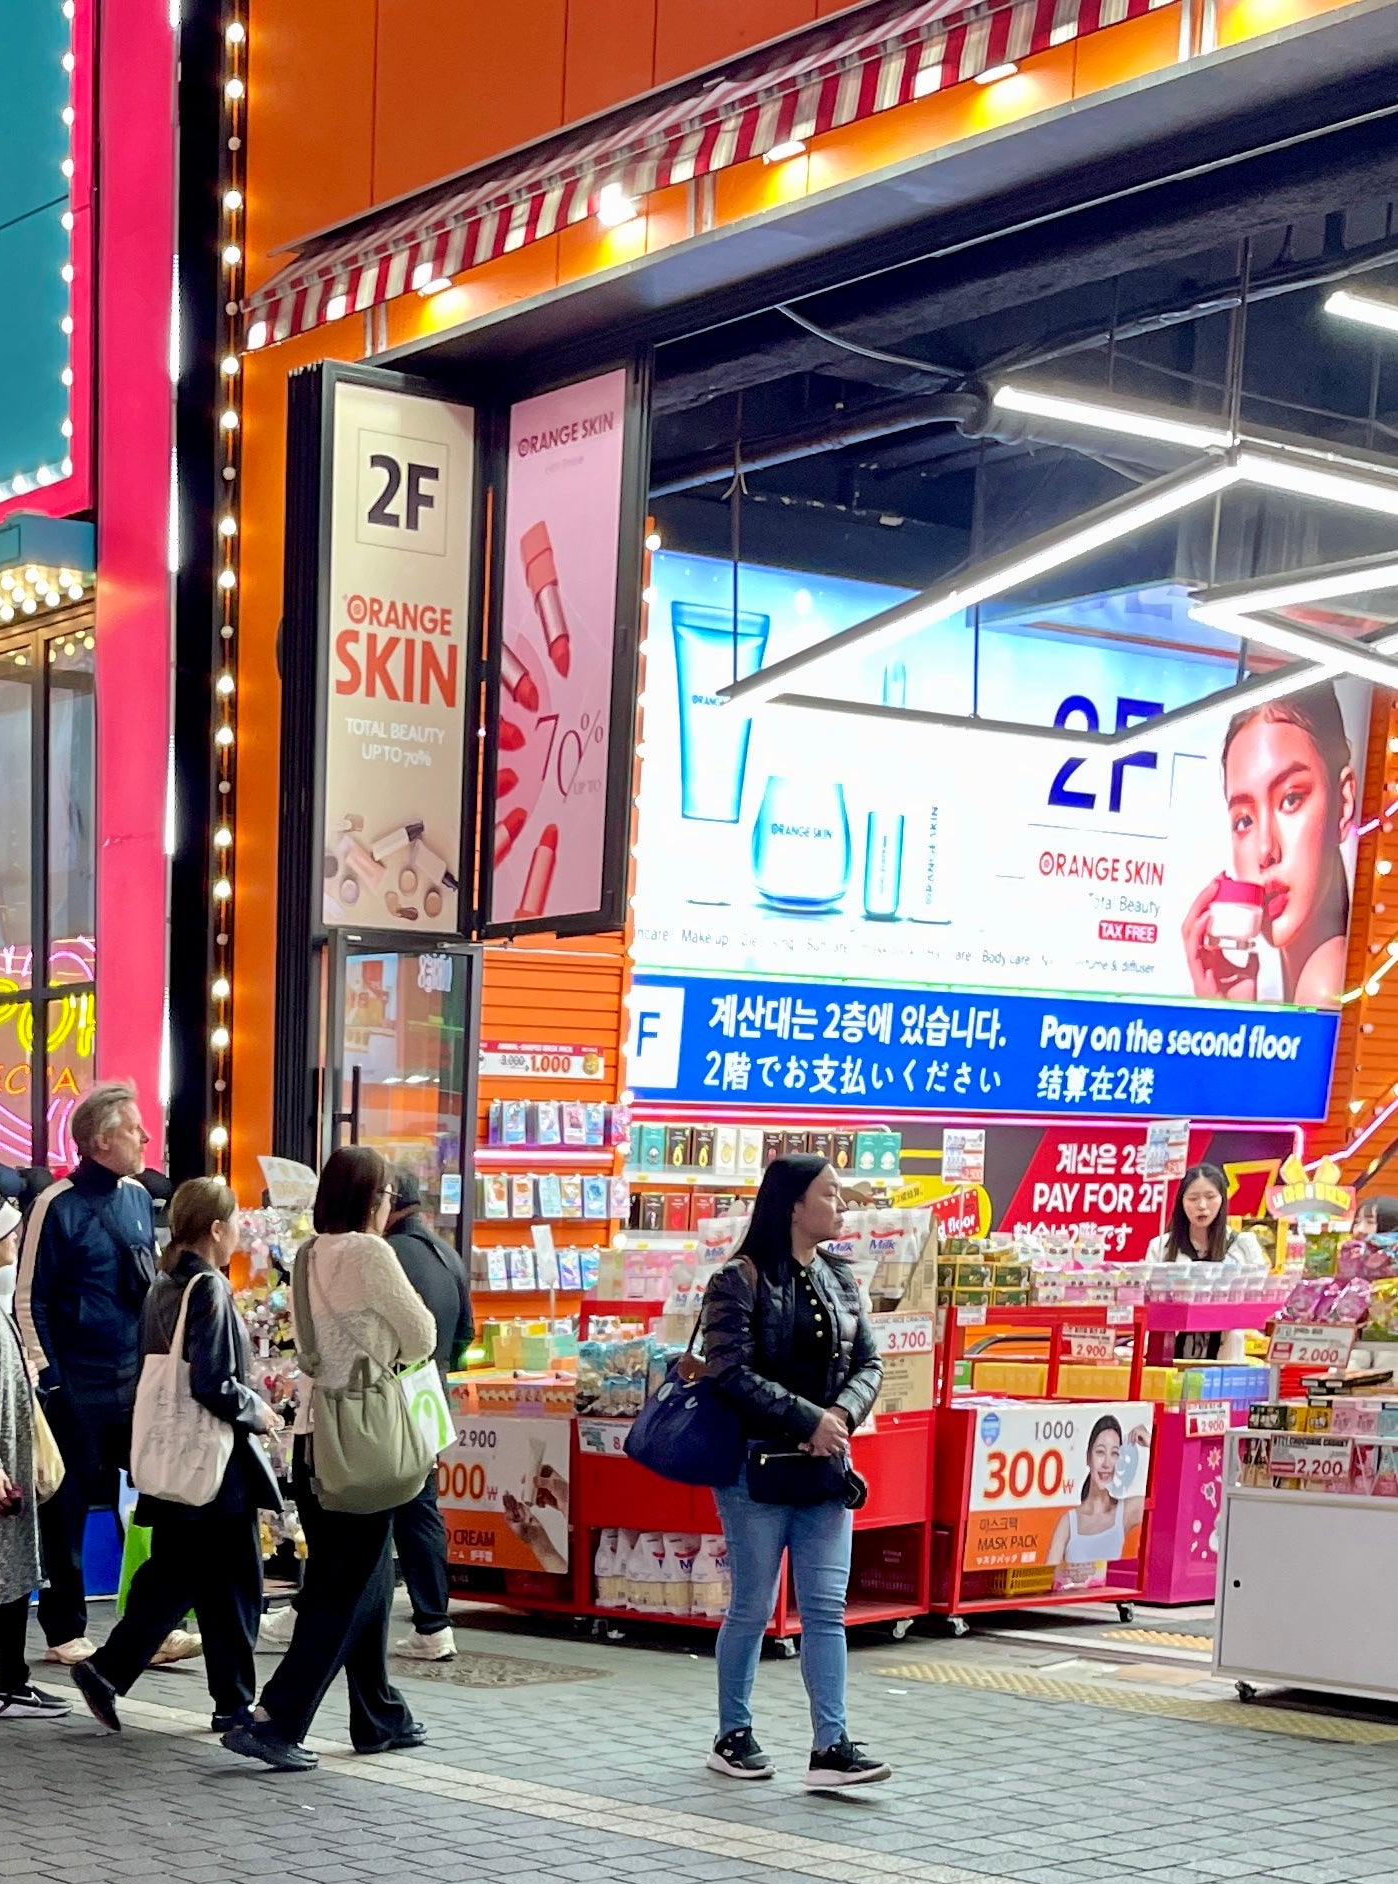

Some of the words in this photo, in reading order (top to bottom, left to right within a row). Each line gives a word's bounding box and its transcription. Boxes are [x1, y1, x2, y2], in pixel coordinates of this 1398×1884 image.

[517, 422, 579, 458] ORANGE
[581, 411, 614, 439] SKIN
[366, 453, 440, 532] 2F
[346, 594, 452, 637] ORANGE
[335, 628, 458, 709] SKIN
[345, 717, 388, 739] TOTAL
[390, 722, 446, 745] BEAUTY
[1048, 695, 1166, 813] 2F
[1039, 851, 1120, 883] ORANGE
[1125, 858, 1165, 887] SKIN
[1118, 896, 1161, 919] Beauty
[1100, 922, 1123, 940] TAX
[1125, 925, 1156, 943] FREE
[636, 1011, 661, 1058] F
[708, 993, 820, 1041] 계산대는
[822, 1001, 894, 1045] 2층에
[899, 1004, 1007, 1050] 있습니다.
[1040, 1014, 1089, 1059] Pay
[1090, 1026, 1122, 1053] on
[1125, 1018, 1163, 1055] the
[1165, 1023, 1247, 1059] second
[1247, 1024, 1302, 1061] floor
[703, 1049, 1003, 1096] 2階でお支払いください
[1036, 1063, 1155, 1105] 结算在2楼
[1055, 1143, 1118, 1175] 계산은
[1032, 1183, 1080, 1213] PAY
[1083, 1182, 1135, 1213] FOR
[1137, 1181, 1169, 1213] 2F
[869, 1239, 896, 1251] Milk
[888, 1331, 926, 1350] 3,700
[1296, 1458, 1343, 1477] 2,200
[453, 1529, 495, 1547] CREAM
[979, 1516, 1019, 1533] 마스크팩
[977, 1536, 1008, 1551] MASK
[1010, 1534, 1039, 1549] PACK
